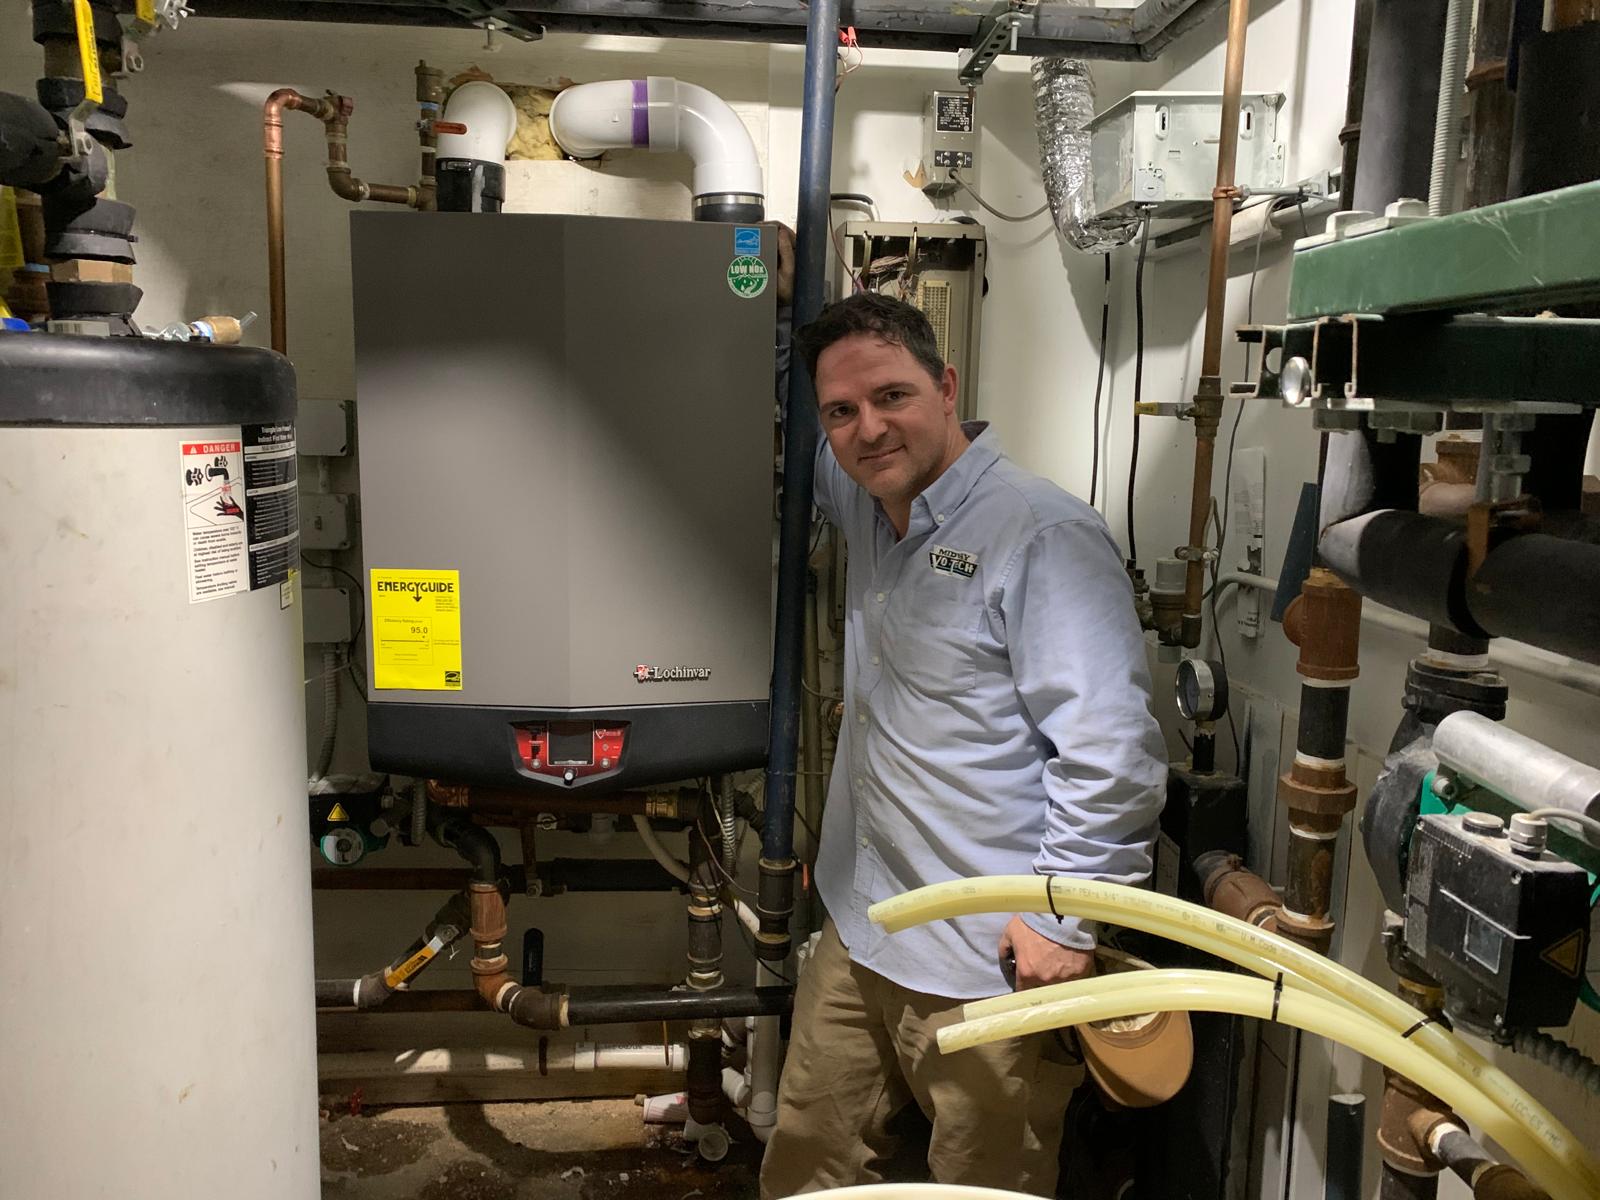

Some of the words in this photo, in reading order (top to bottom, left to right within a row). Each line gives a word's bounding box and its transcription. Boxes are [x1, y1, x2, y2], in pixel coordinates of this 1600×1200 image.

[730, 265, 748, 274] LOW
[203, 444, 236, 453] DANGER
[377, 581, 454, 595] ENERGYGUIDE
[410, 626, 428, 634] 95.0
[653, 666, 711, 679] Lochinvar
